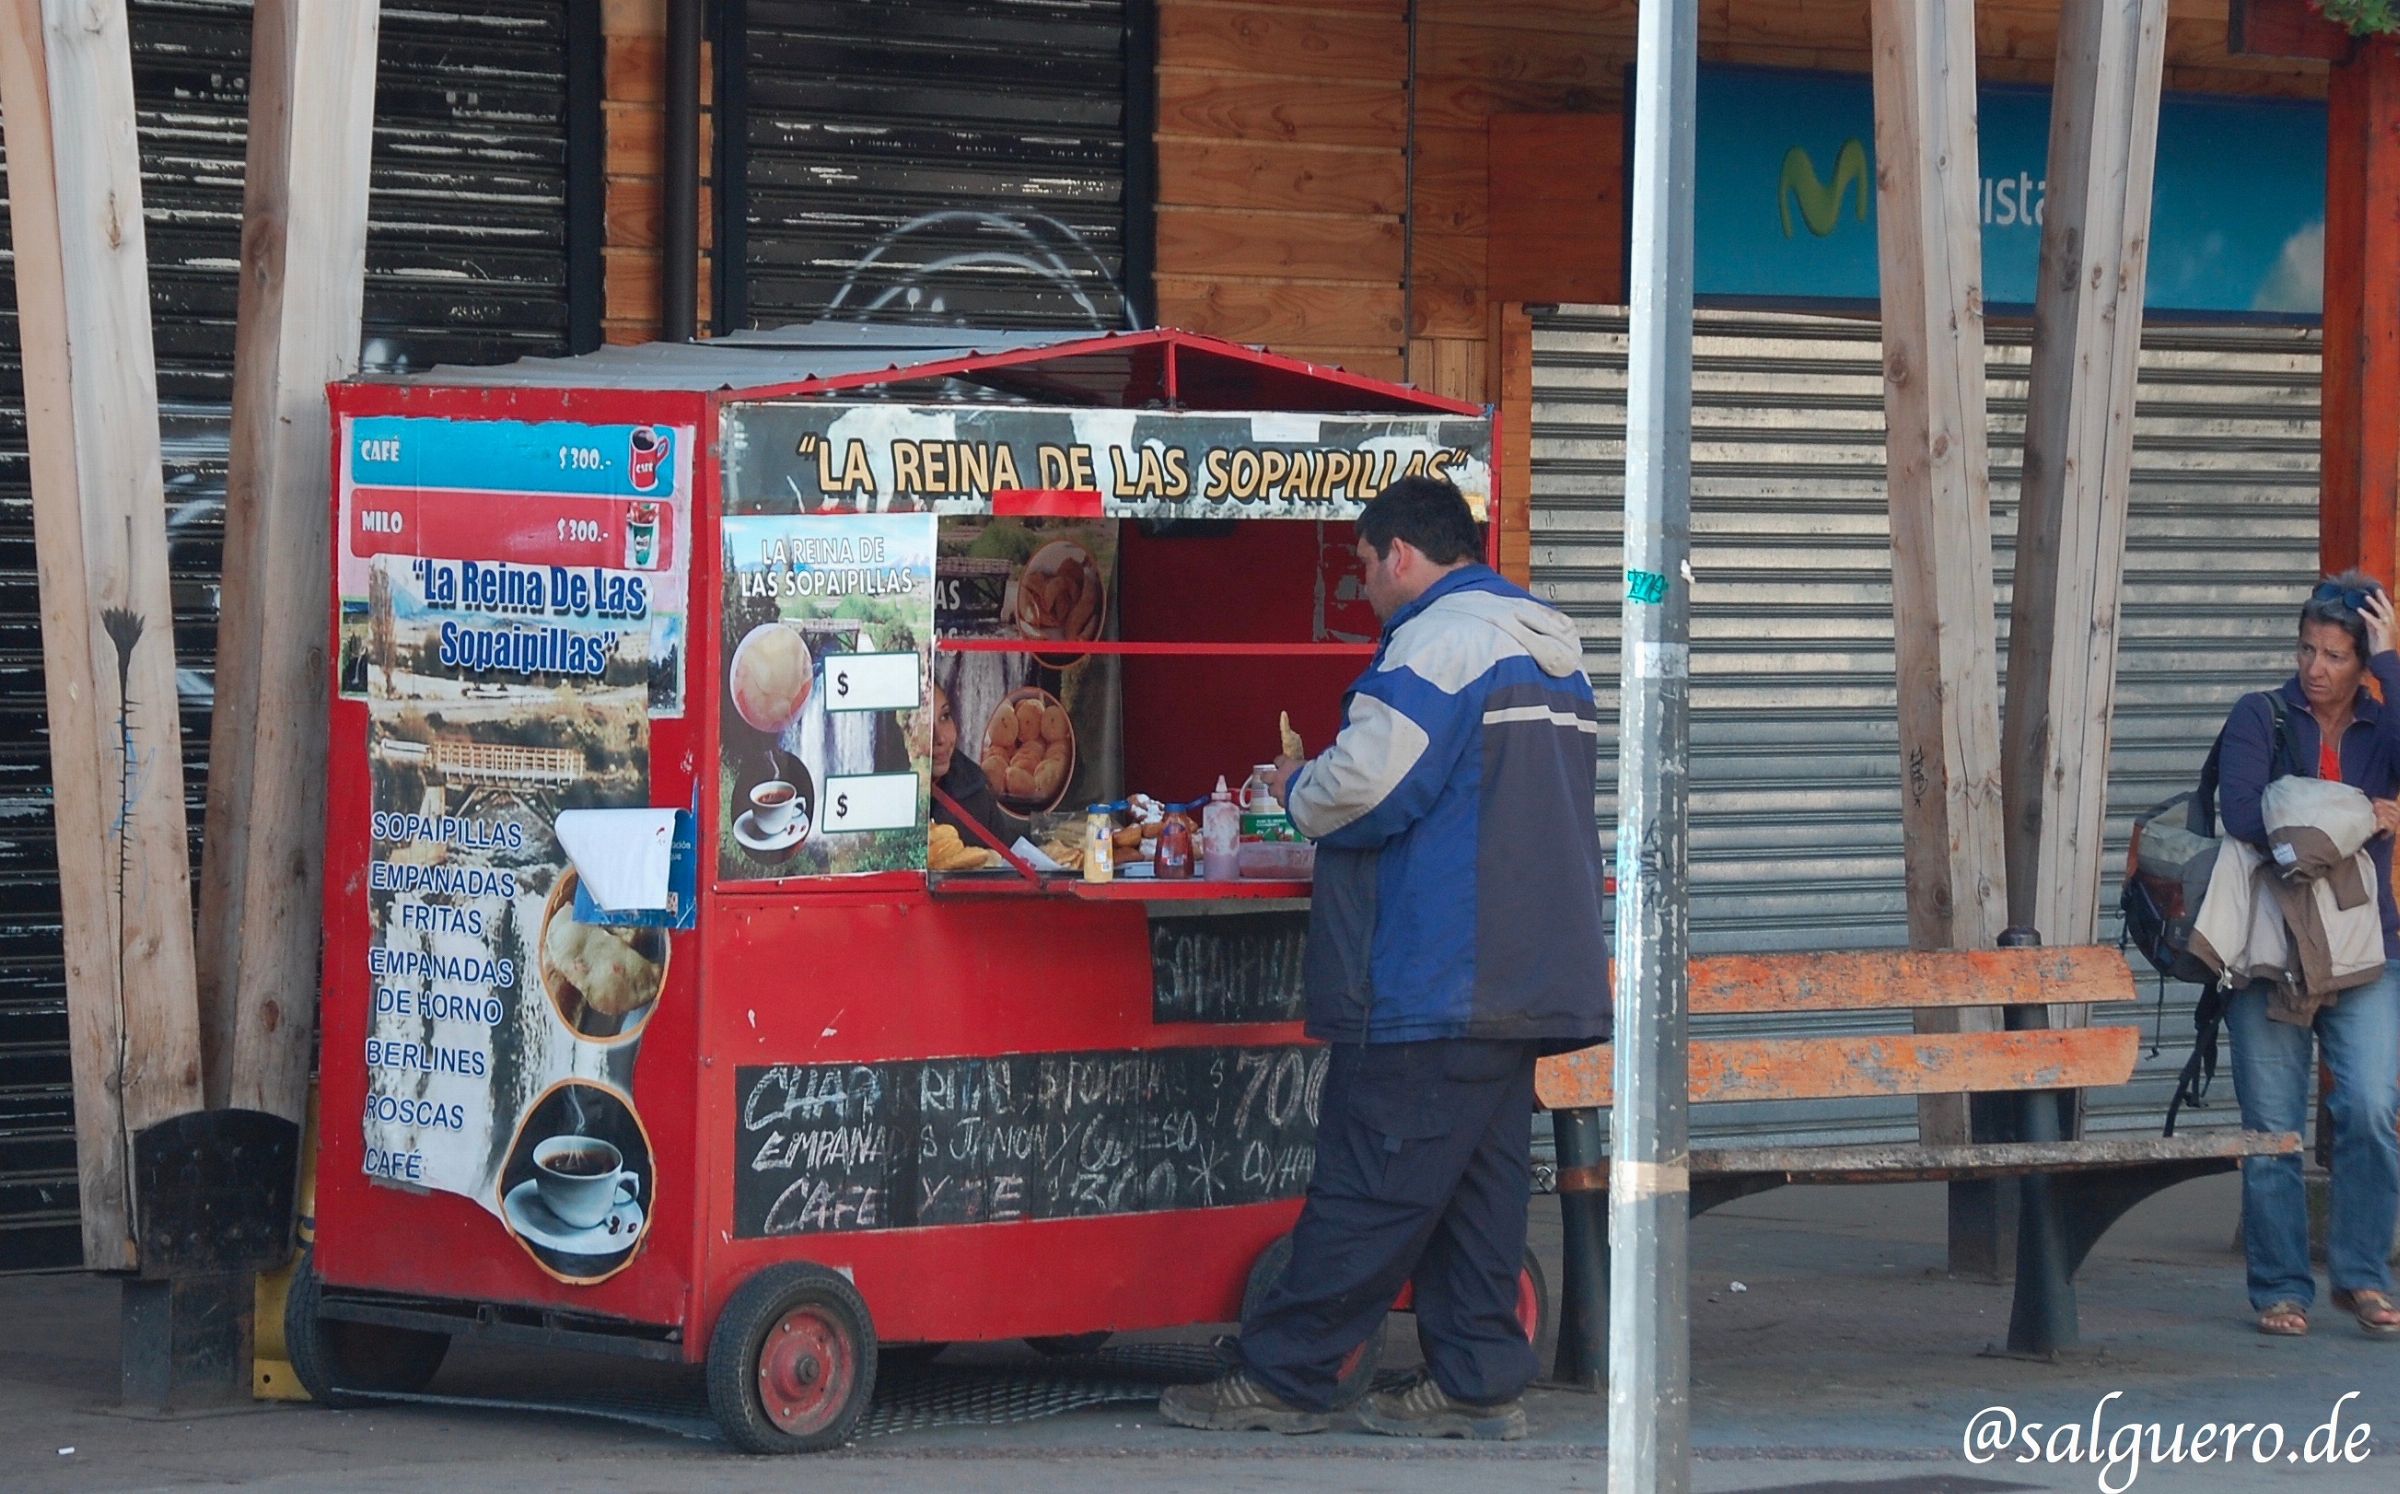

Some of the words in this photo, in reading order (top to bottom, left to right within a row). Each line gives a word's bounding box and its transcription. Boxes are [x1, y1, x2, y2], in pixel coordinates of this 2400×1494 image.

[892, 438, 1022, 493] REINA
[1037, 443, 1097, 493] DE
[1110, 445, 1190, 499] LAS
[361, 511, 402, 534] MILO
[761, 540, 787, 565] LA
[794, 538, 851, 564] REINA
[859, 537, 885, 562] DE
[461, 561, 544, 607] Reina
[550, 566, 588, 610] De
[594, 567, 644, 613] Las
[741, 572, 779, 598] LAS
[785, 567, 914, 596] SOPAIPILLAS
[440, 621, 616, 674] Sopaipillas”
[837, 671, 849, 698] $
[836, 792, 848, 819] $
[372, 812, 522, 849] SOPAIPILLAS
[372, 863, 515, 897] EMPANADAS
[403, 904, 482, 935] FRITAS
[371, 951, 514, 985] EMPANADAS
[377, 988, 411, 1015] DE
[417, 990, 503, 1025] HORNO
[367, 1040, 485, 1076] BERLINES
[366, 1095, 465, 1129] ROSCAS
[365, 1148, 422, 1179] CAFÉ
